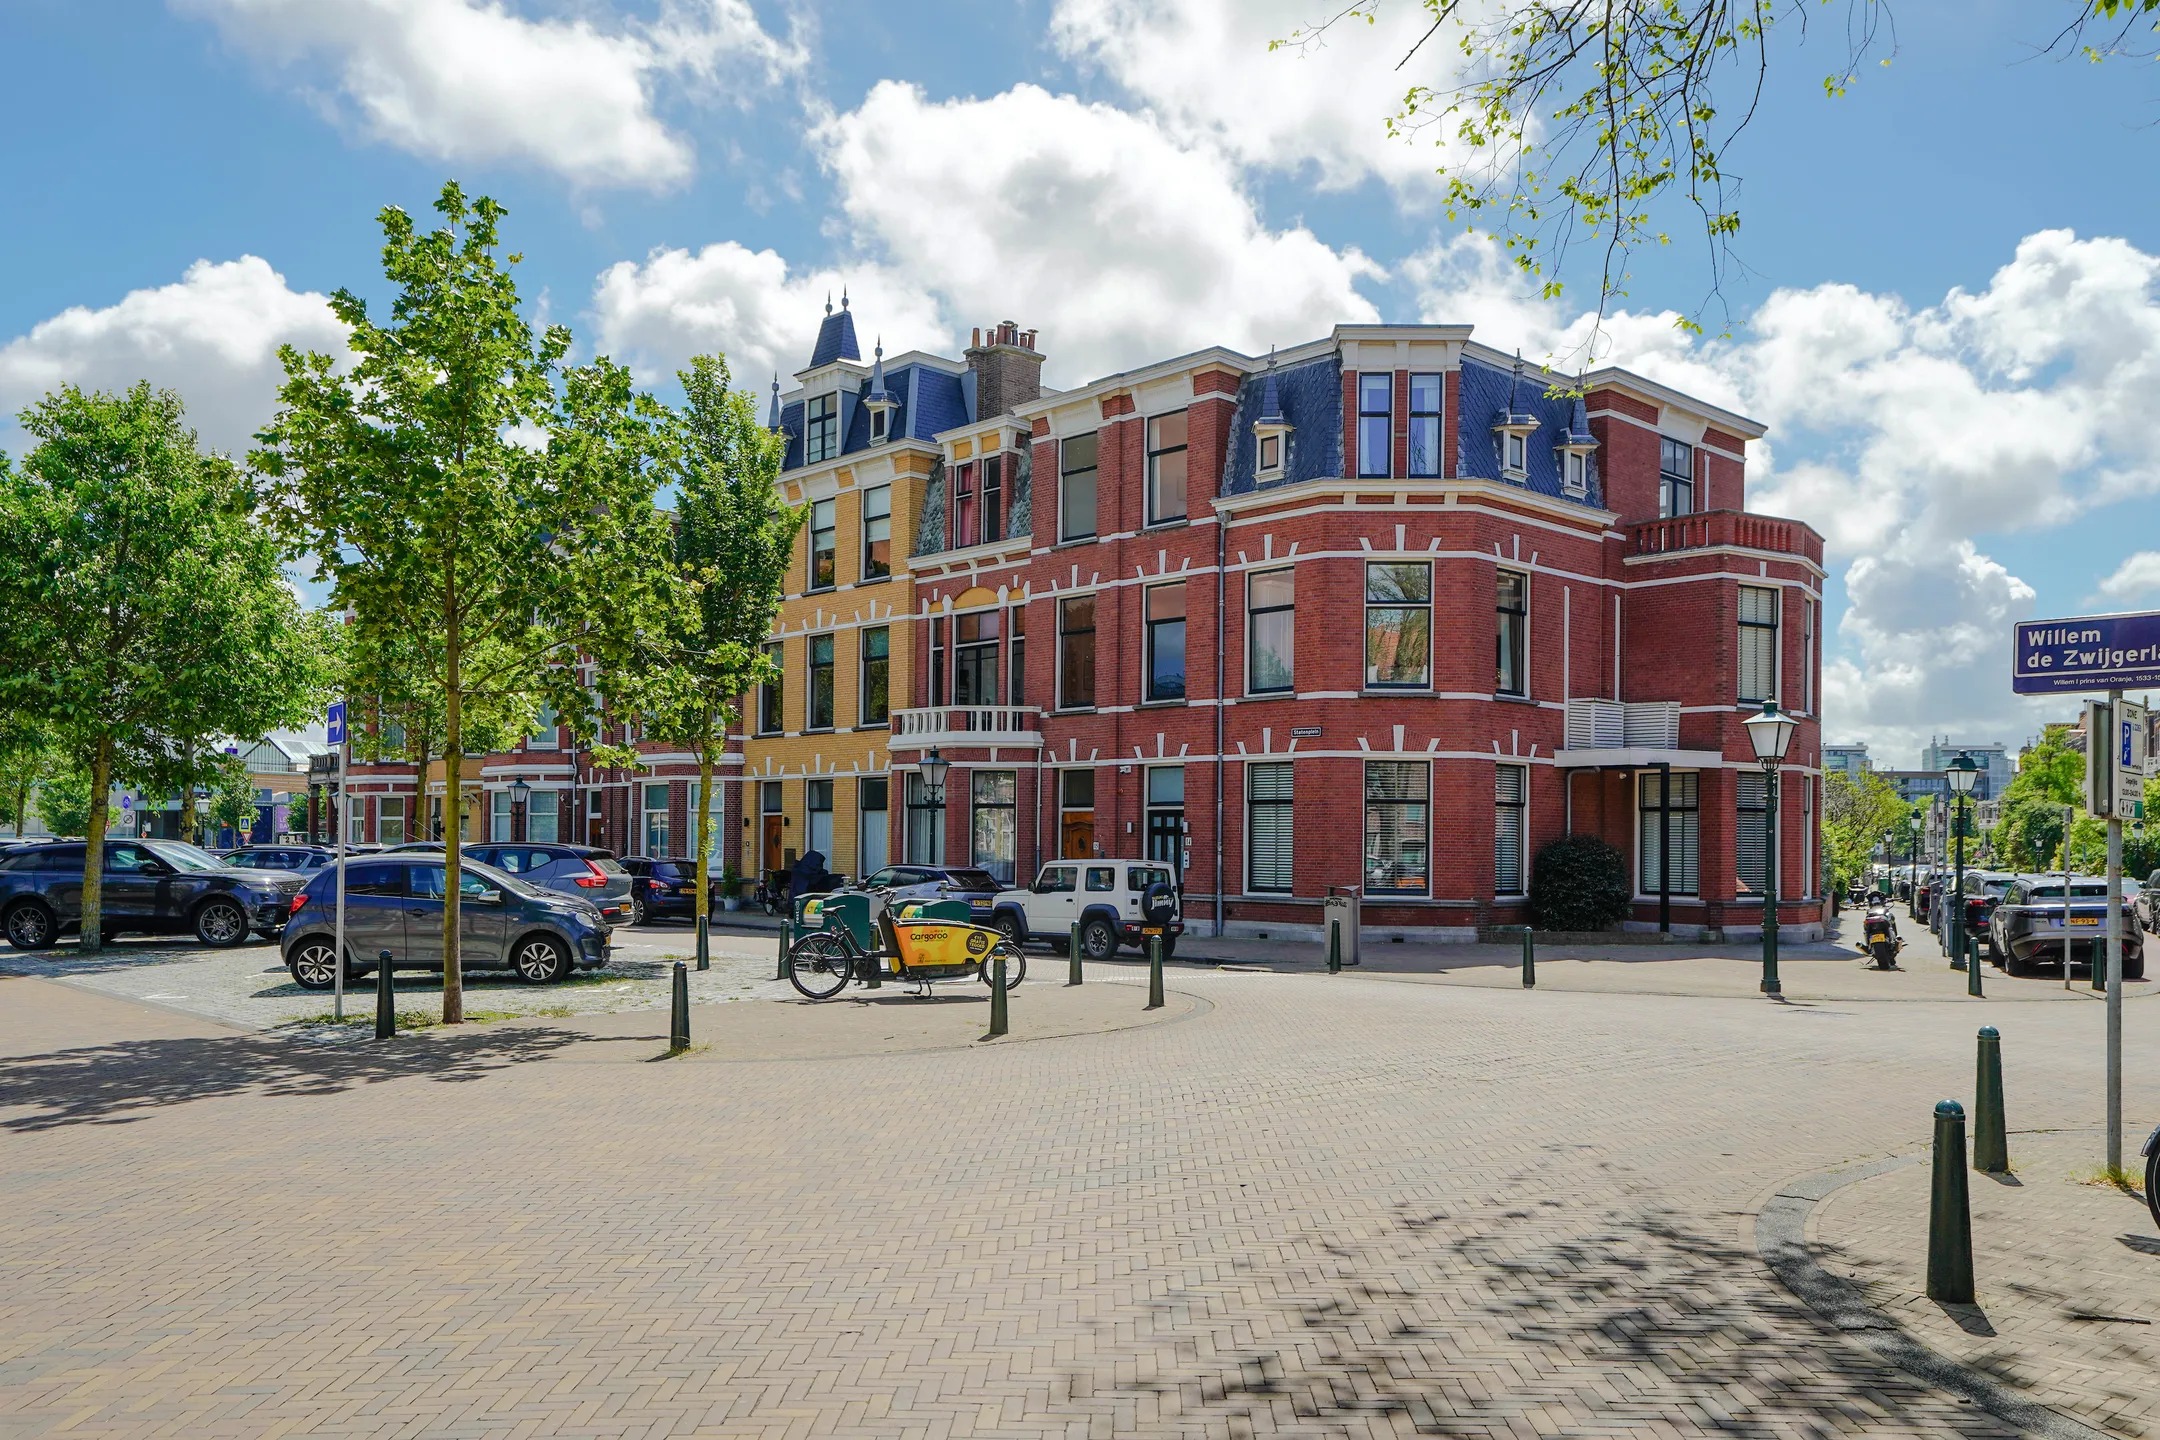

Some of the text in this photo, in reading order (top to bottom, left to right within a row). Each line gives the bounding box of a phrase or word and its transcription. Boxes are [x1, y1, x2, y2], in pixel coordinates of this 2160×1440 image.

[2028, 629, 2101, 647] Willem
[2027, 644, 2160, 669] de Zwijgerl
[2080, 678, 2095, 686] prins
[2109, 676, 2133, 684] Oranje,
[2126, 708, 2138, 720] ZONE
[1151, 898, 1174, 910] Jimny
[910, 933, 949, 942] Cargoroo
